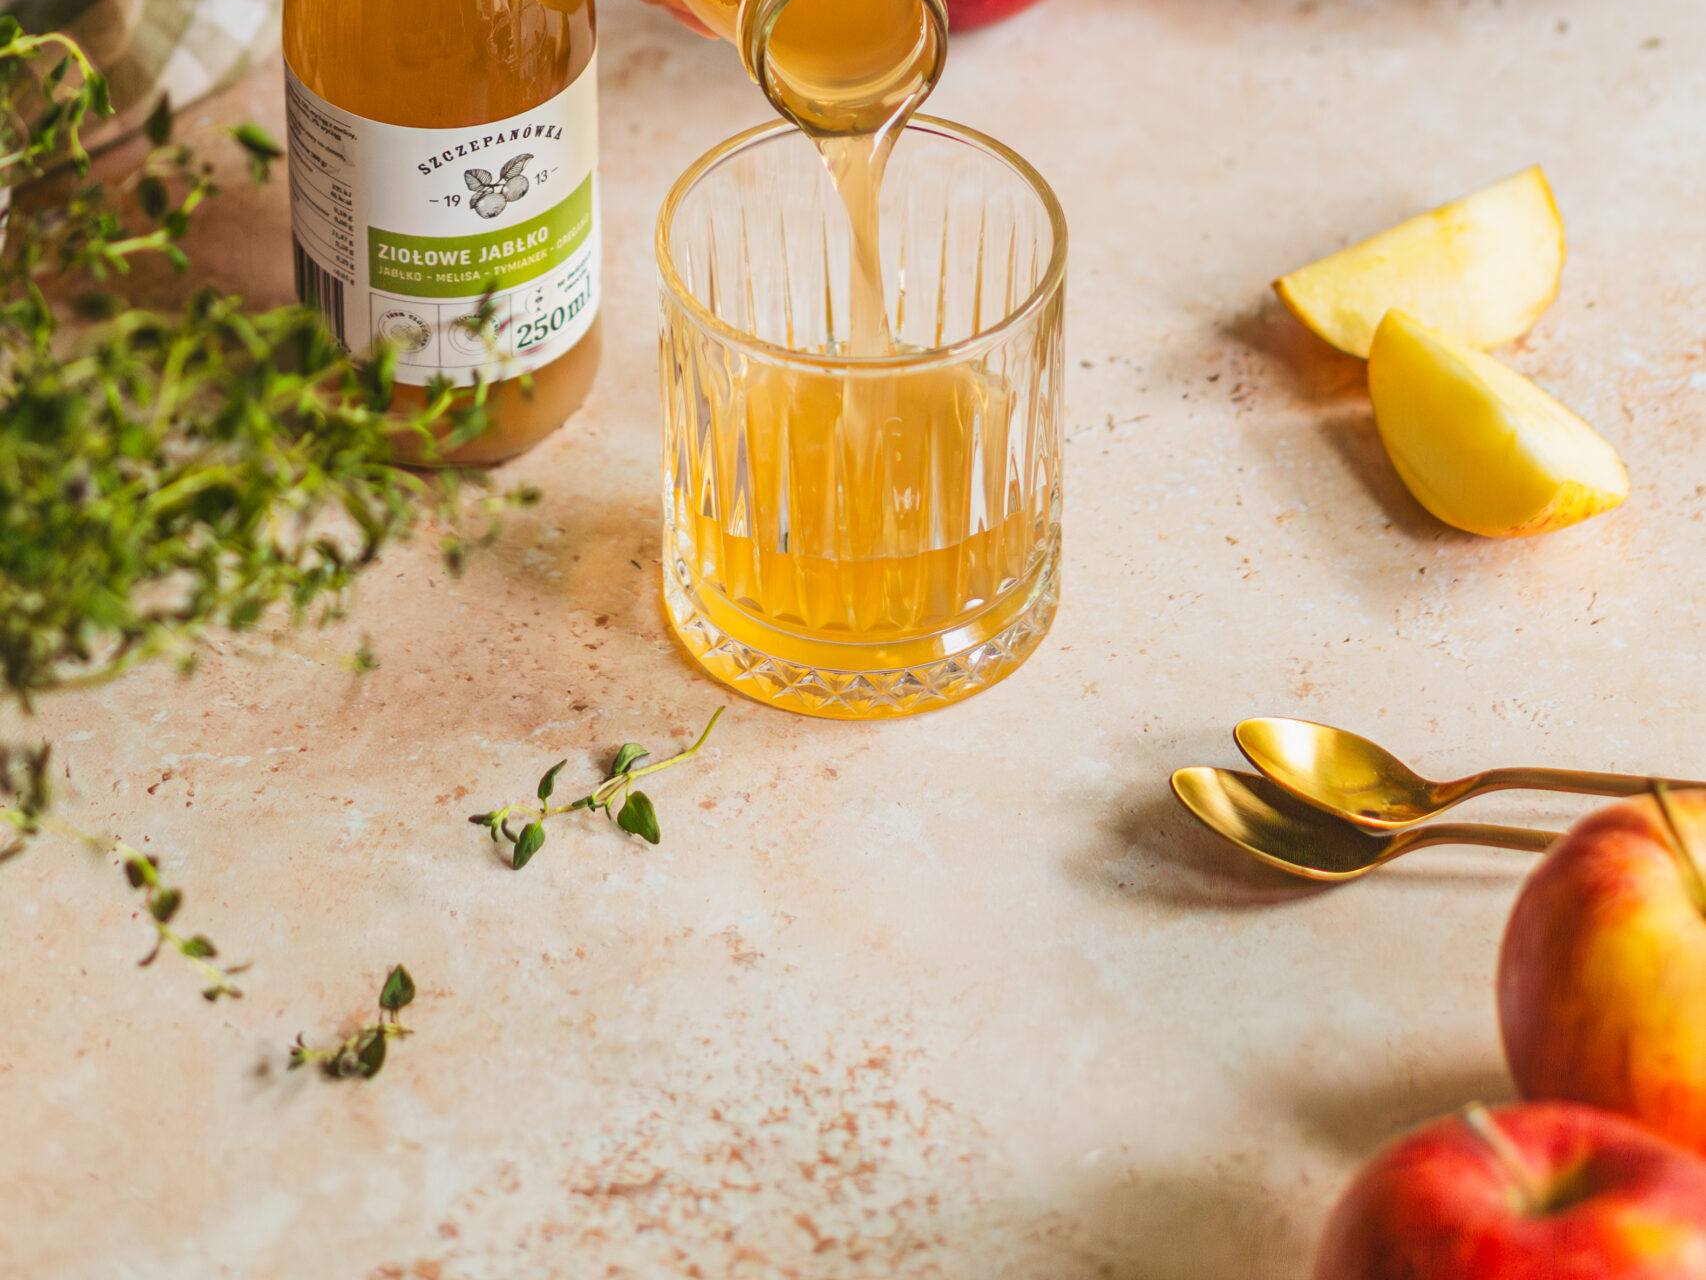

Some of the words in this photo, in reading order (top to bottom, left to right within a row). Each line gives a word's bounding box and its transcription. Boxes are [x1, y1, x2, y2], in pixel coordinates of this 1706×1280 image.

[417, 124, 563, 176] SZCZEPANÓWKA
[443, 194, 461, 207] 19
[534, 170, 548, 185] 13
[377, 265, 422, 282] JABŁKO
[435, 271, 481, 283] MELISA
[493, 247, 549, 276] TYMIANEK
[378, 243, 472, 266] ZIOŁOWE
[478, 225, 549, 264] JABŁKO
[516, 272, 591, 349] 250ml
